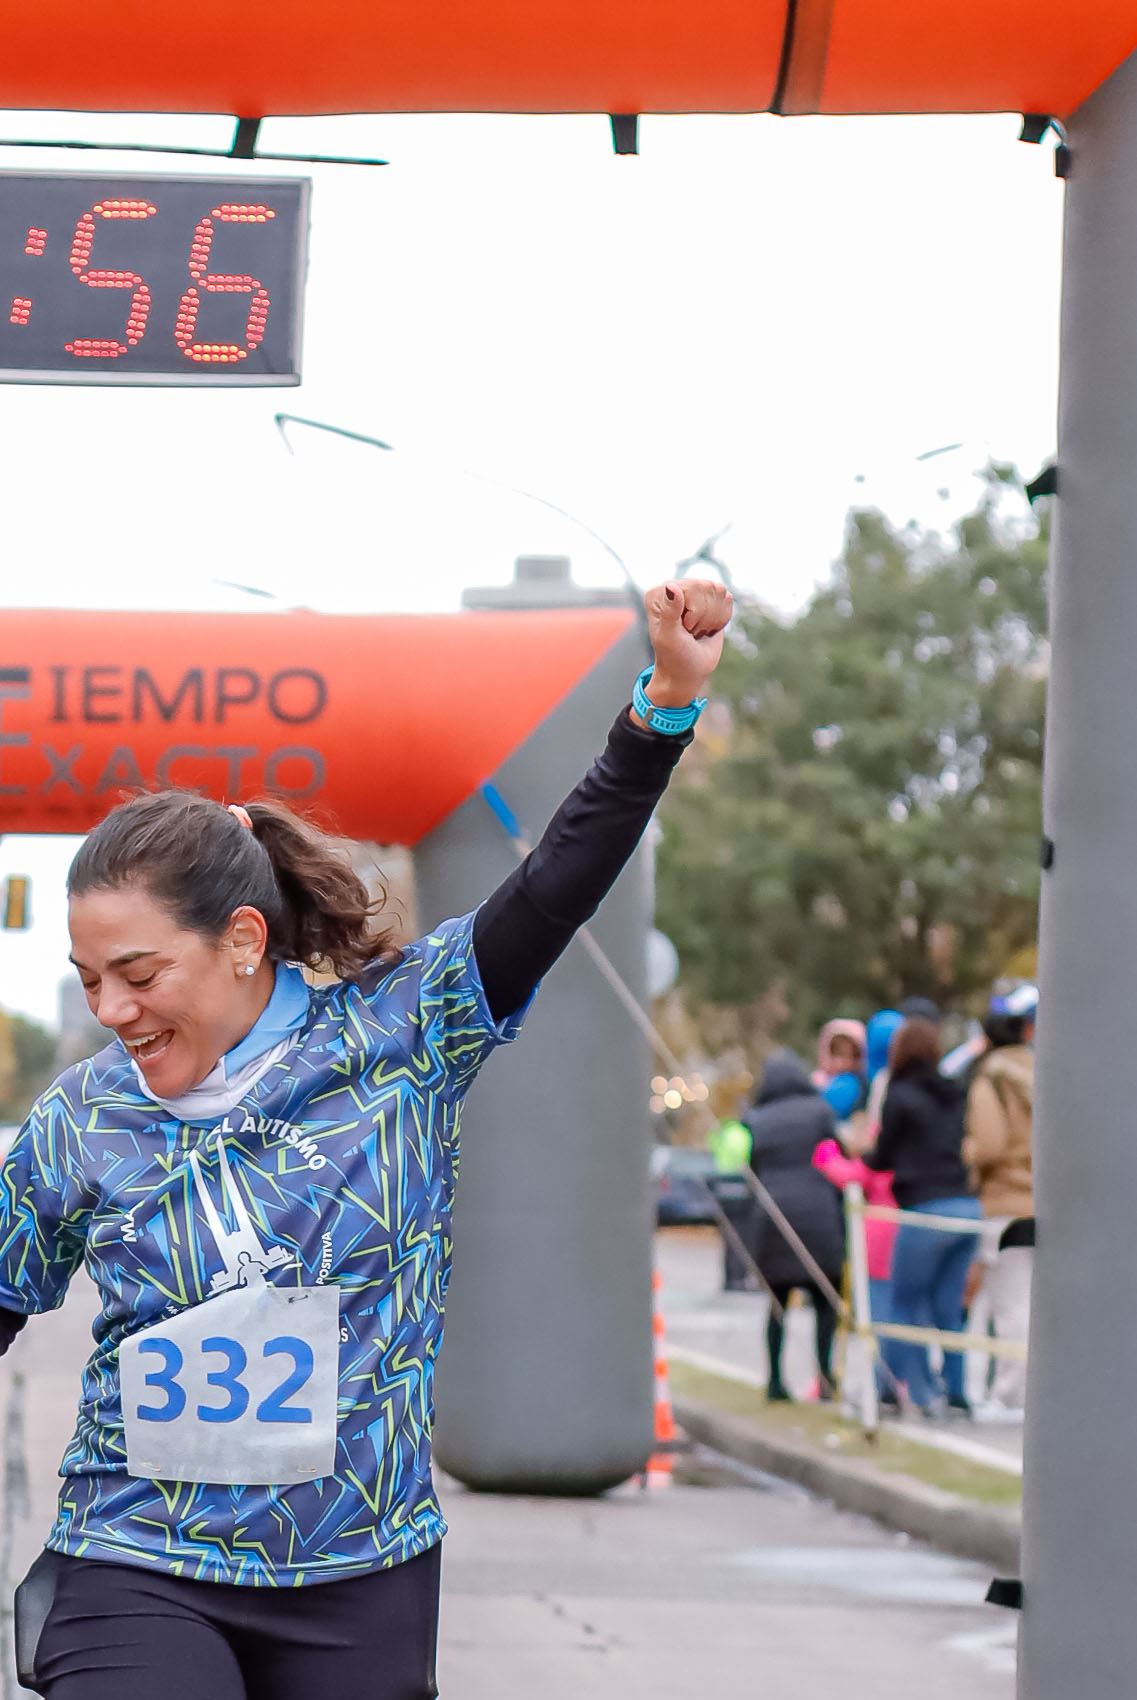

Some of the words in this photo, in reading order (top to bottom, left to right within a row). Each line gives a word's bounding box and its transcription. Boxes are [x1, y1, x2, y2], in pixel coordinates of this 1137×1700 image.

[239, 1116, 327, 1171] AUTISMO
[315, 1231, 333, 1285] POSITIVA
[137, 1336, 314, 1423] 332
